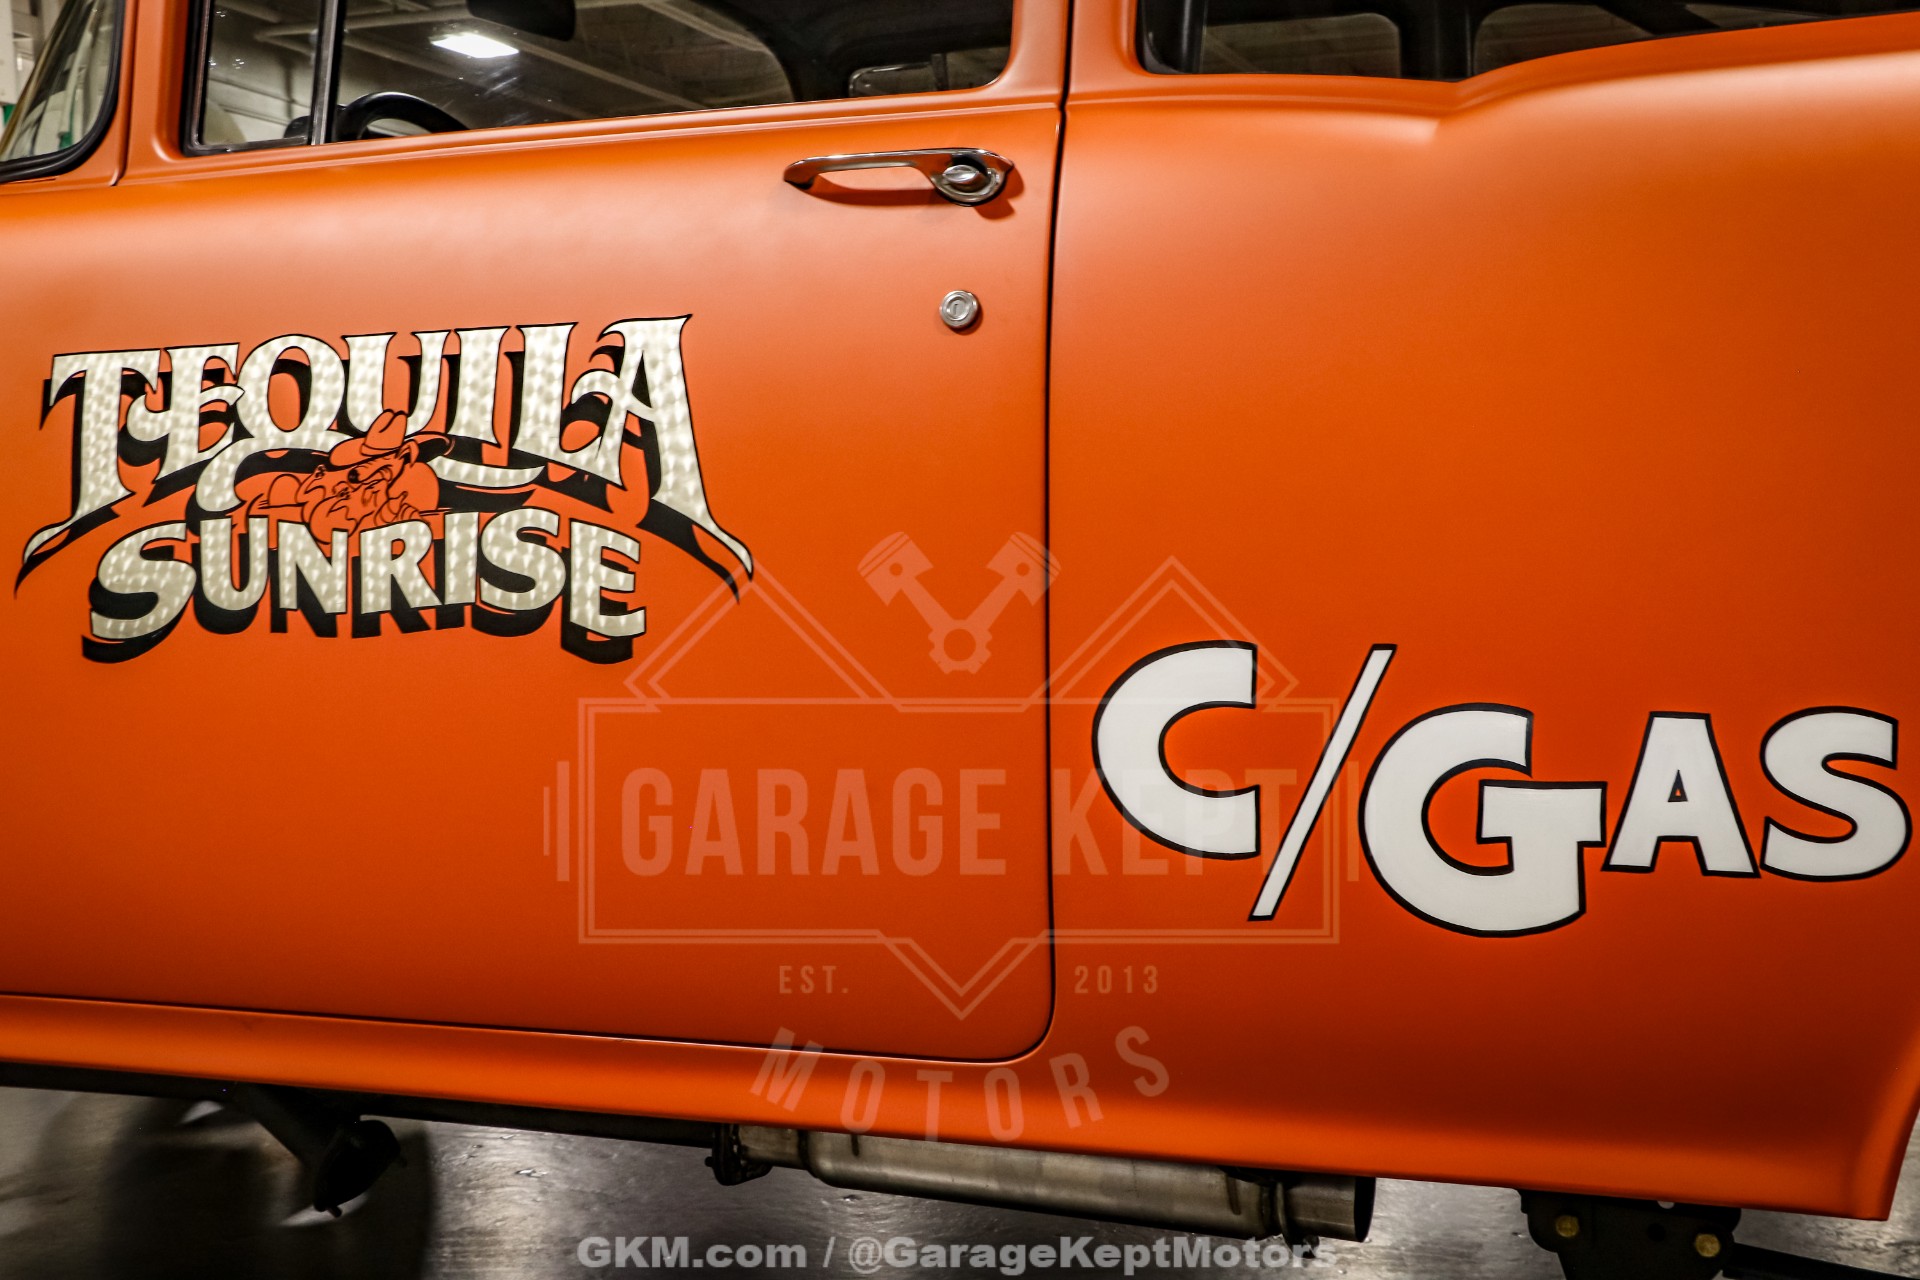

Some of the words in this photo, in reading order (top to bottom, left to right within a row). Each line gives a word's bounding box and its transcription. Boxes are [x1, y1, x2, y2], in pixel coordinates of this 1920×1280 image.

[18, 313, 755, 594] TEQUILA
[86, 507, 648, 656] SUNRISE
[1092, 640, 1912, 937] C/GAS
